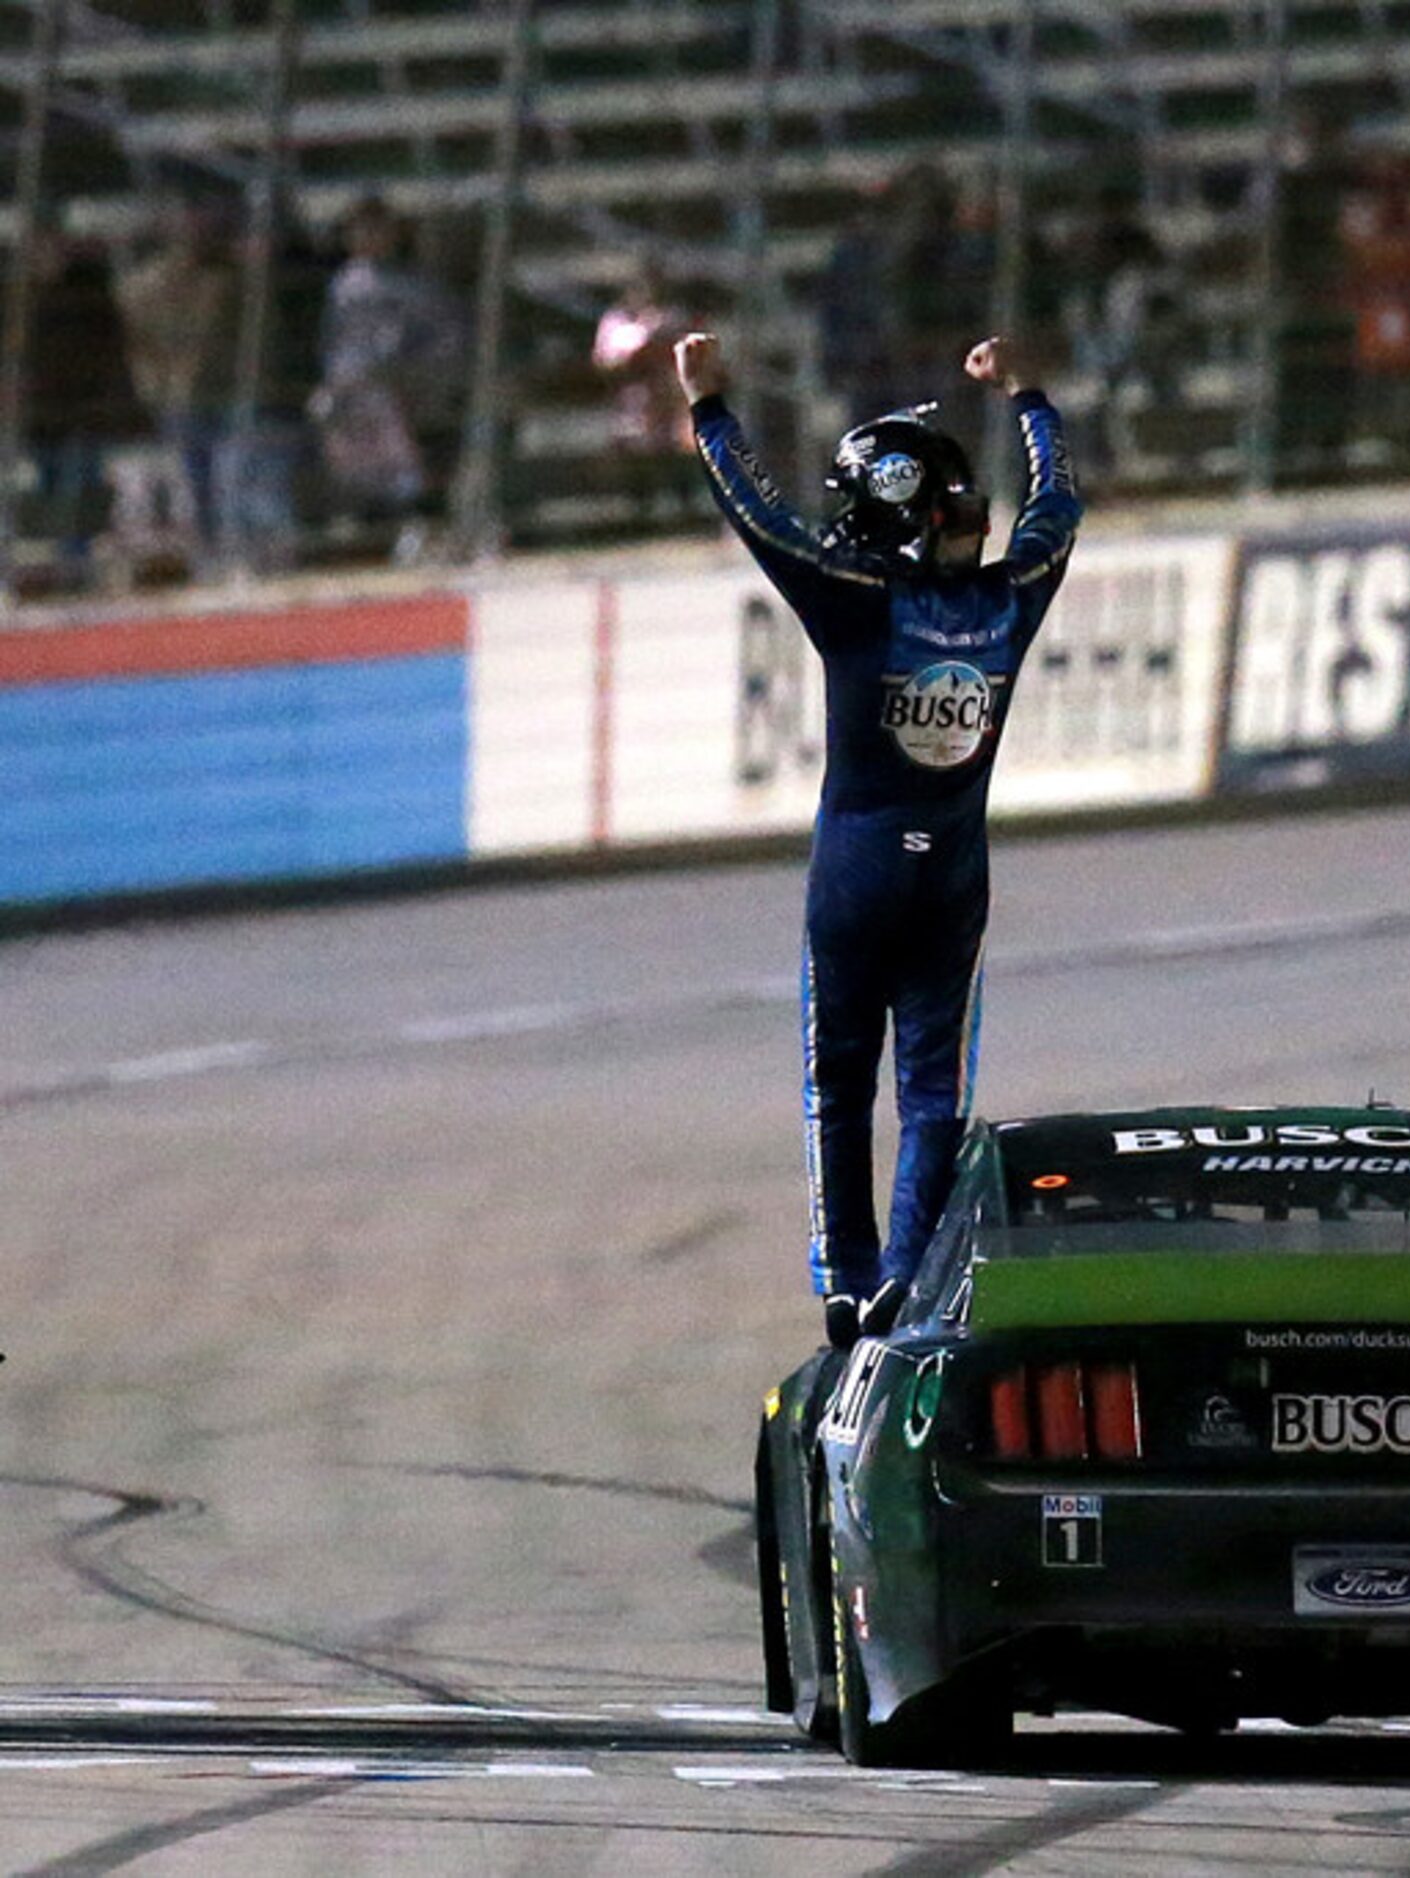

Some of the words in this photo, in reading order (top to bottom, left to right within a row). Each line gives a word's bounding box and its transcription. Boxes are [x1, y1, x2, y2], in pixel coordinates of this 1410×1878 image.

[869, 459, 925, 494] BUSCH
[884, 692, 995, 730] BUSCH
[1044, 1497, 1101, 1513] Mobil
[1060, 1521, 1079, 1561] 1
[1333, 1568, 1410, 1596] Ford
